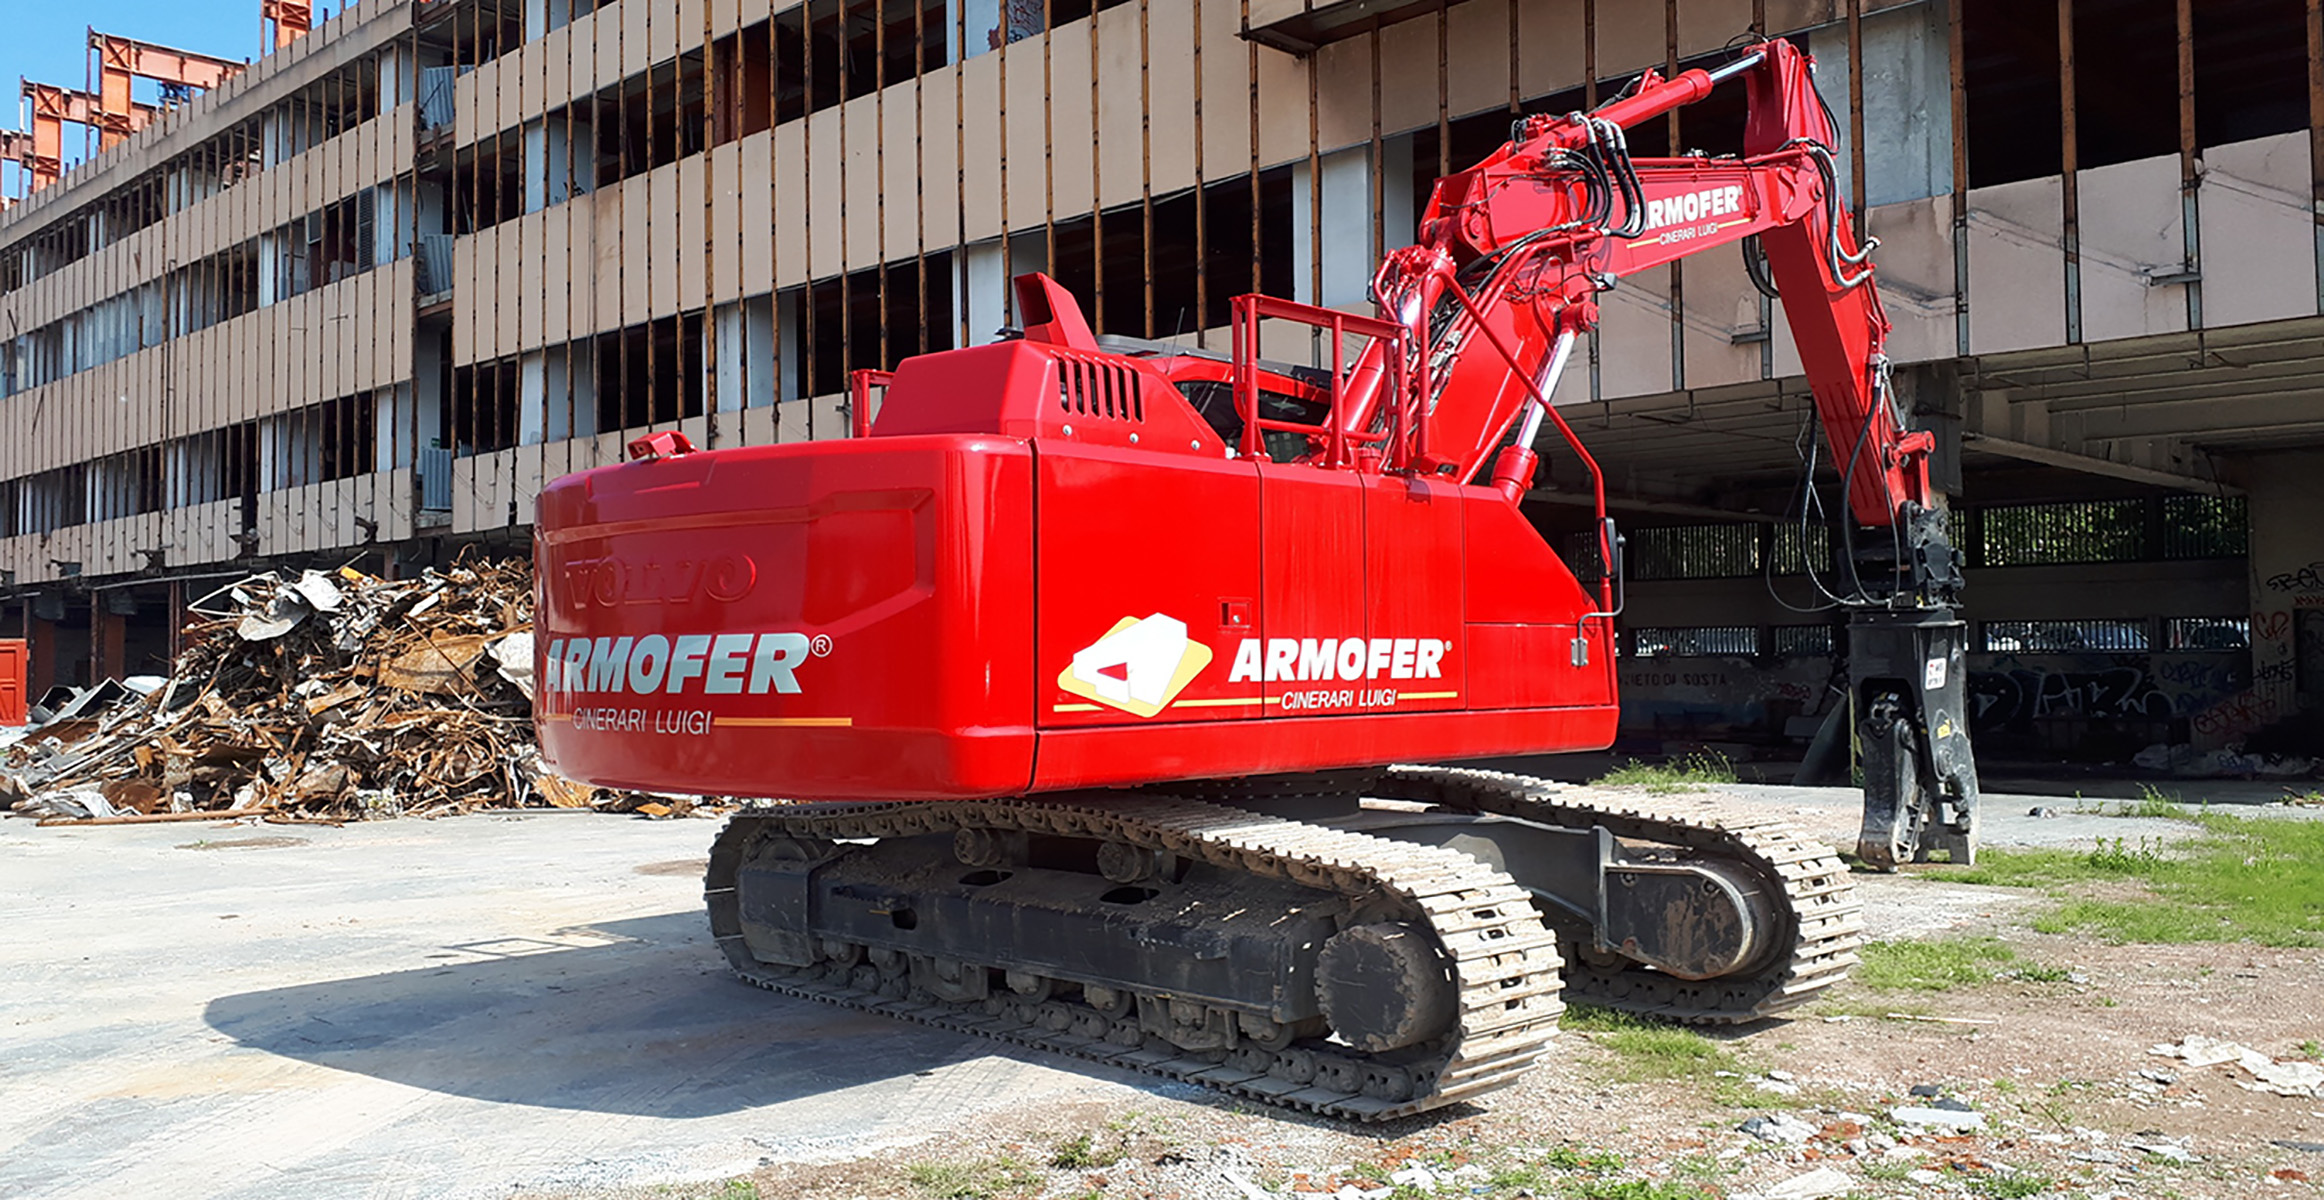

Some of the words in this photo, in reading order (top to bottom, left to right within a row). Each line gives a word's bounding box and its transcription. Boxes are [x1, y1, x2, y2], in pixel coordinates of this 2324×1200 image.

[1659, 225, 1696, 246] CINERARI
[1698, 222, 1718, 238] LUIGI
[565, 554, 757, 609] VOLVO
[1281, 690, 1353, 710] CINERARI
[1359, 688, 1398, 707] LUIGI
[573, 707, 647, 732] CINERARI
[656, 709, 712, 735] LUIGI
